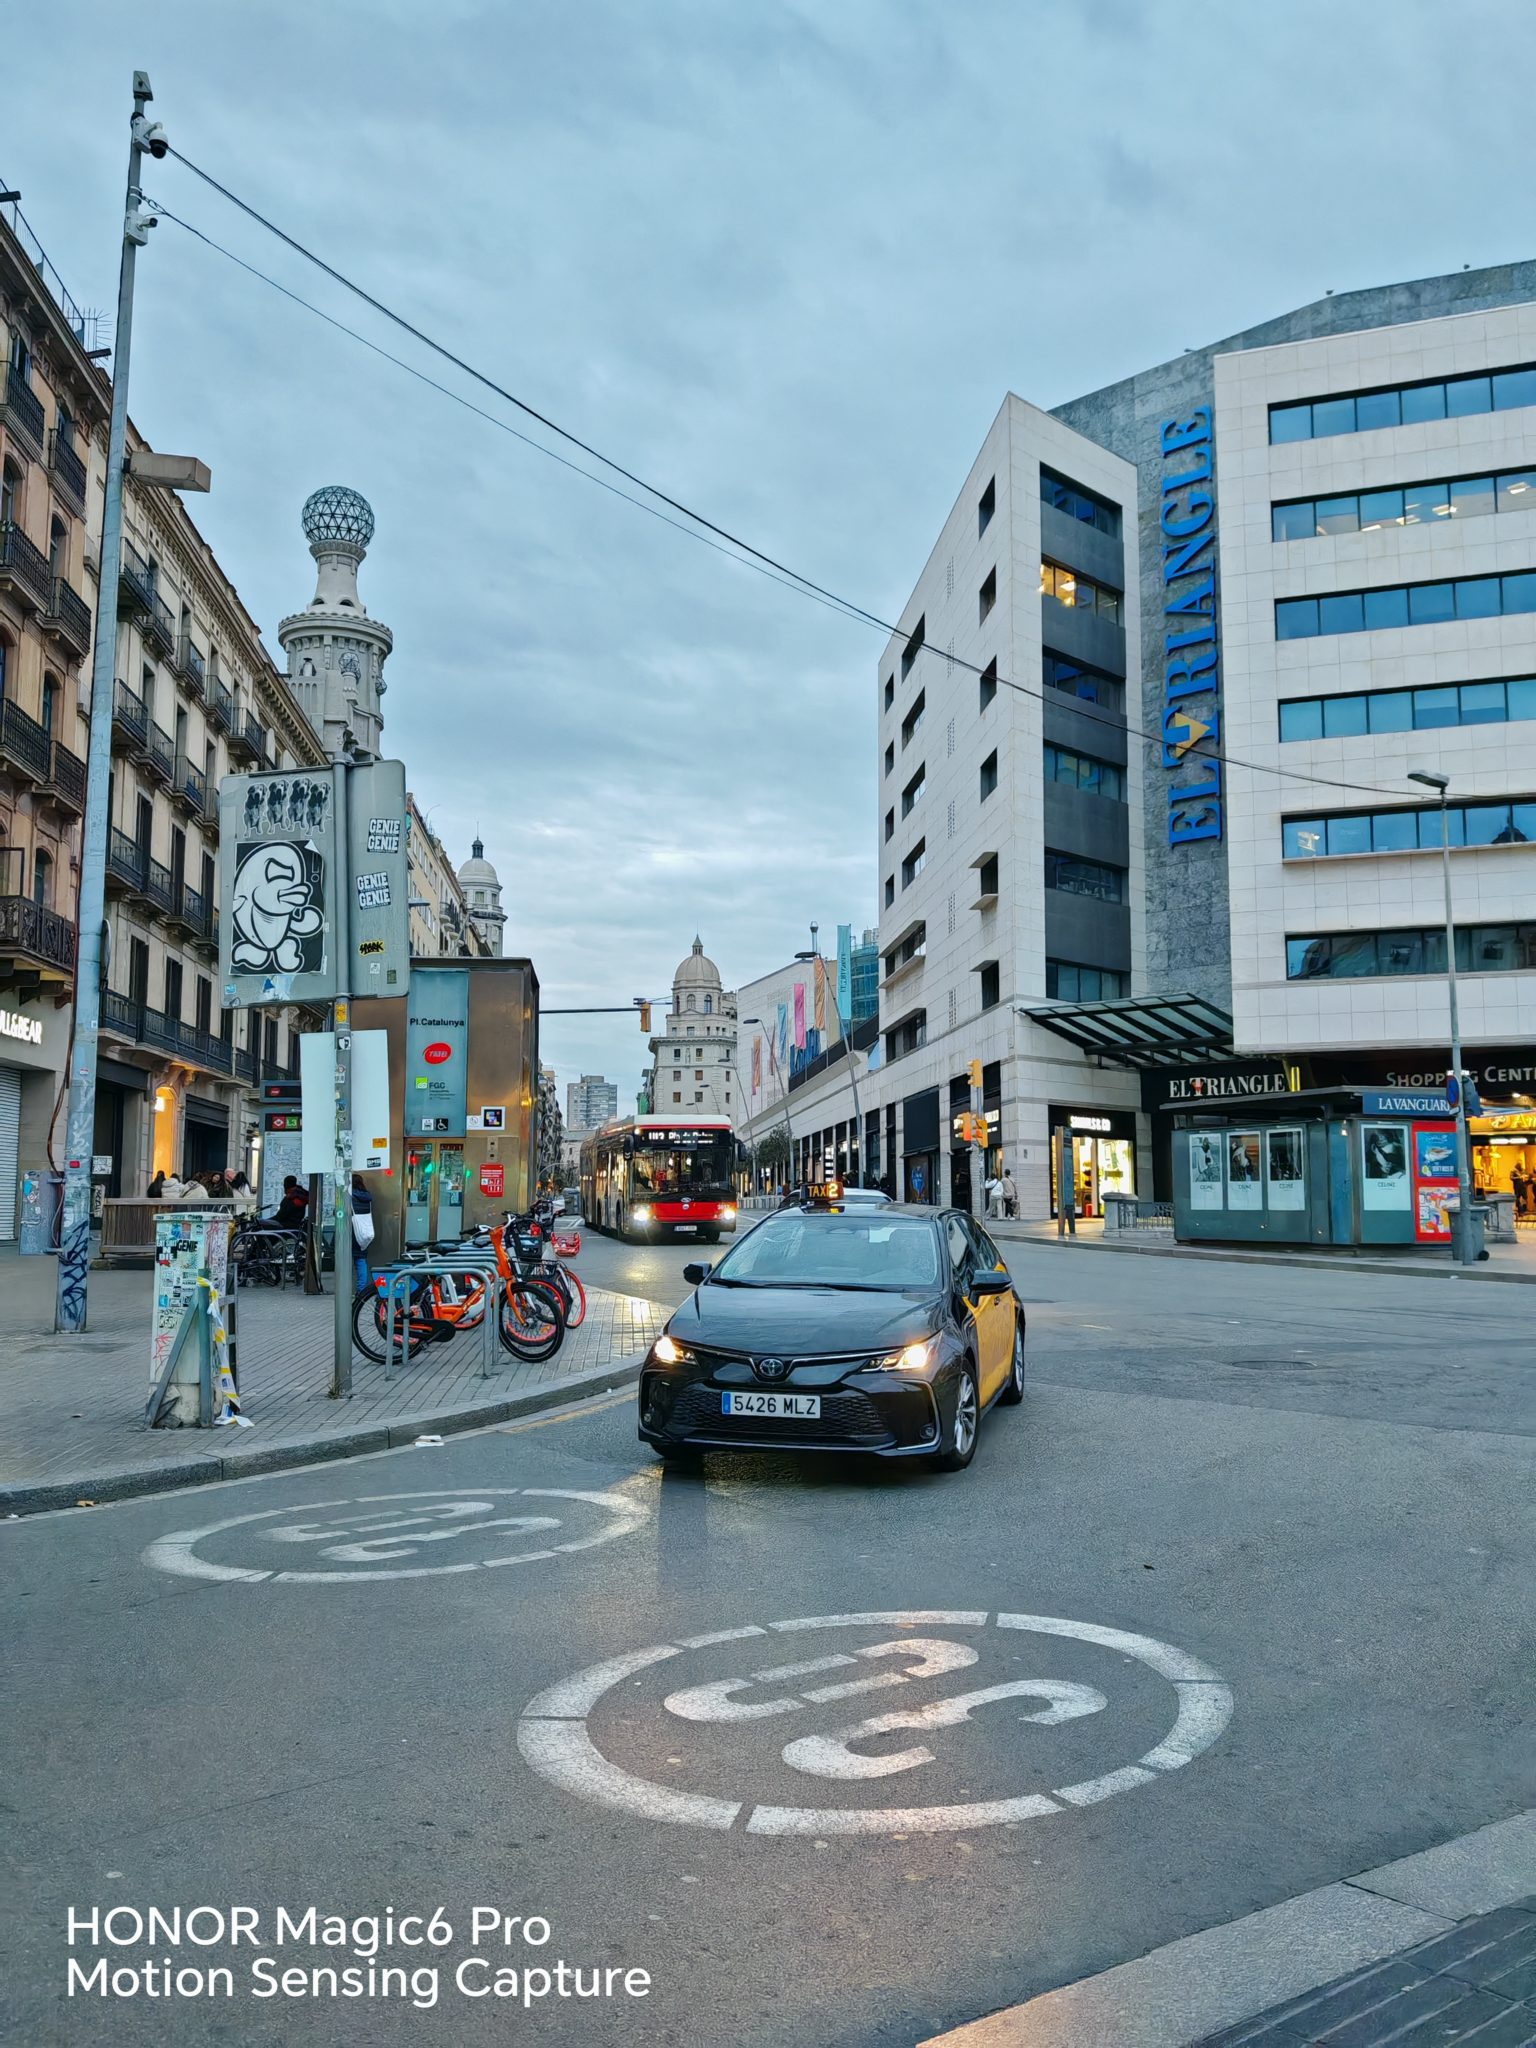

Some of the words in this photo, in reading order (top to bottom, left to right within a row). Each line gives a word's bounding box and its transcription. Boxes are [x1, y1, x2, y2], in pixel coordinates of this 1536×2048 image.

[1160, 405, 1222, 768] TRIANGLE
[1167, 760, 1222, 849] EL
[370, 819, 400, 834] GENIE
[368, 836, 399, 850] GENIE
[357, 872, 388, 890] GENIE
[359, 889, 390, 907] GENIE
[0, 1009, 42, 1044] LL&BEAR
[1386, 1070, 1478, 1087] SHOPPG
[1484, 1066, 1536, 1082] CENT
[1169, 1080, 1190, 1098] EL
[1189, 1074, 1286, 1097] TRIANGLE
[1379, 1098, 1391, 1110] LA
[286, 1119, 297, 1127] L3
[807, 1185, 828, 1198] TAXI
[829, 1182, 839, 1198] 2
[734, 1395, 777, 1413] 5426
[783, 1398, 816, 1415] MLZ
